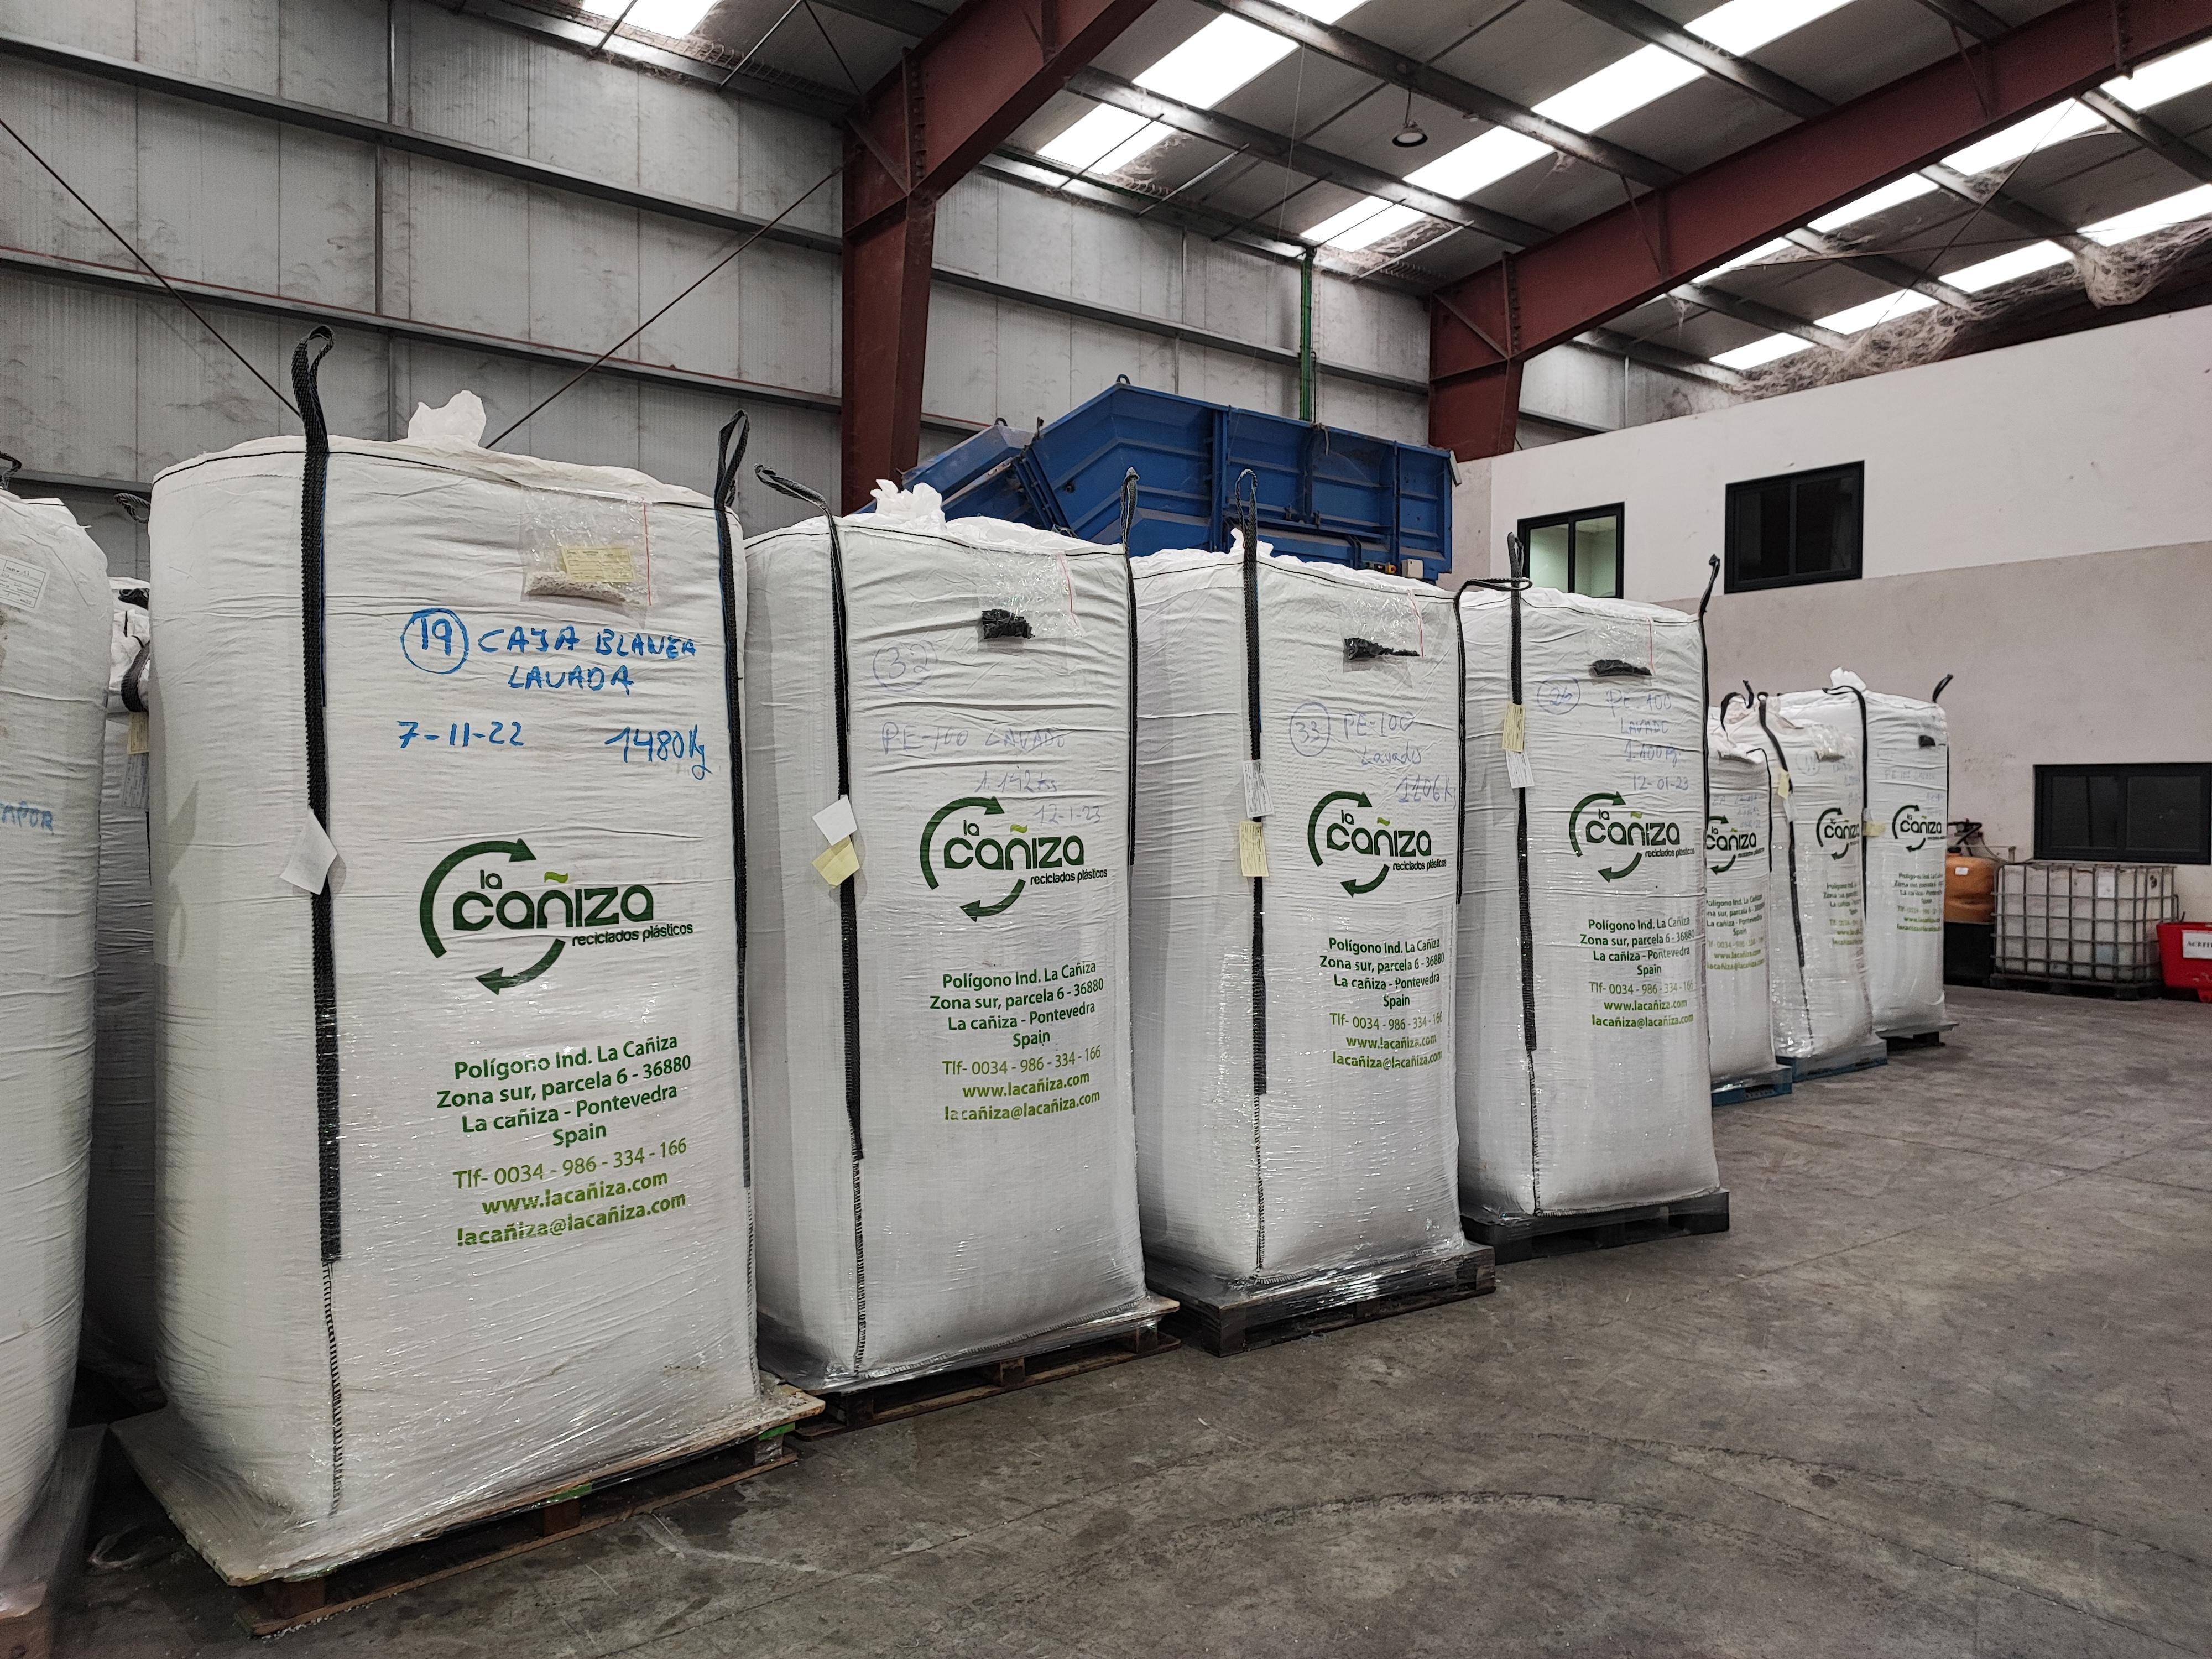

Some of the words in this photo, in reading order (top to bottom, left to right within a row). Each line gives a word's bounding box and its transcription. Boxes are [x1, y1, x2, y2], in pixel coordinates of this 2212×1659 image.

[420, 618, 452, 656] 19
[478, 625, 579, 653] CAJA
[508, 665, 634, 695] LAVADA
[397, 721, 524, 748] 7-11-22
[963, 820, 979, 836] la
[1341, 810, 1354, 825] la
[1645, 848, 1674, 857] reciclados
[1030, 872, 1075, 885] reciclados
[1078, 868, 1108, 883] plásticos
[1393, 861, 1425, 870] reciclados
[480, 869, 502, 889] la
[453, 872, 654, 931] cañiza
[572, 930, 639, 946] reciclados
[643, 922, 693, 943] plásticos
[1588, 919, 1635, 933] Polígono
[1637, 920, 1655, 930] Ind.
[1657, 919, 1666, 929] La
[1668, 916, 1690, 928] Cañiza
[1329, 937, 1381, 955] Polígono
[1385, 941, 1403, 953] Ind.
[1405, 941, 1415, 952] La
[1417, 938, 1439, 951] Cañiza
[1580, 934, 1608, 945] Zona
[1611, 937, 1629, 947] sur,
[1632, 934, 1663, 947] parcela
[1666, 933, 1670, 943] 6
[1677, 929, 1695, 942] 36880
[1319, 956, 1351, 969] Zona
[1355, 961, 1374, 973] sur,
[1378, 959, 1412, 974] parcela
[1415, 958, 1419, 969] 6
[1426, 952, 1444, 967] 36880
[1593, 951, 1605, 961] La
[1609, 951, 1640, 961] cañiza
[1648, 946, 1690, 960] Pontevedra
[943, 973, 1011, 992] Polígono
[1016, 969, 1041, 985] Ind.
[1044, 968, 1058, 982] La
[1061, 961, 1096, 978] Cañiza
[1334, 974, 1348, 987] La
[1352, 978, 1386, 990] cañiza
[1395, 972, 1439, 989] Pontevedra
[1637, 964, 1661, 977] Spain
[930, 995, 971, 1009] Zona
[975, 997, 1001, 1010] sur,
[1005, 988, 1053, 1010] parcela
[1057, 987, 1064, 1000] 6
[1074, 978, 1104, 997] 36880
[1609, 984, 1634, 995] 0034
[1642, 984, 1658, 994] 986
[1664, 983, 1677, 993] 334
[1383, 994, 1410, 1009] Spain
[1604, 1000, 1687, 1011] www.lacañiza.com
[948, 1017, 966, 1030] La
[971, 1015, 1018, 1030] cañiza
[1030, 1001, 1095, 1025] Pontevedra
[1329, 1013, 1349, 1025] Tlf-
[1353, 1016, 1379, 1030] 0034
[1389, 1019, 1405, 1030] 986
[1413, 1016, 1426, 1029] 334
[1433, 1011, 1442, 1024] 166
[1592, 1014, 1694, 1029] lacañiza@lacañiza.com
[1013, 1030, 1050, 1050] Spain
[1346, 1034, 1437, 1049] www.lacañiza.com
[455, 1056, 550, 1081] Polígono
[556, 1047, 592, 1068] Ind.
[597, 1045, 618, 1063] La
[623, 1036, 678, 1058] Cañiza
[942, 1060, 967, 1075] Tlf-
[972, 1061, 1008, 1075] 0034
[1020, 1057, 1044, 1073] 986
[1055, 1051, 1076, 1068] 334
[1084, 1045, 1101, 1061] 166
[437, 1089, 493, 1108] Zona
[499, 1085, 536, 1102] sur,
[542, 1071, 612, 1101] parcela
[617, 1068, 628, 1084] 6
[643, 1055, 691, 1079] 36880
[962, 1072, 1089, 1098] www.lacañiza.com
[462, 1115, 487, 1133] La
[493, 1107, 559, 1130] cañiza
[577, 1084, 677, 1118] Pontevedra
[945, 1091, 1100, 1120] lacañiza@lacañiza.com
[553, 1123, 607, 1147] Spain
[453, 1168, 488, 1190] Tlf-
[494, 1163, 544, 1185] 0034
[562, 1156, 596, 1177] 986
[613, 1147, 645, 1168] 334
[660, 1138, 687, 1159] 166
[482, 1171, 667, 1215] www.lacañiza.com
[457, 1192, 686, 1247] lacañiza@lacañiza.com
